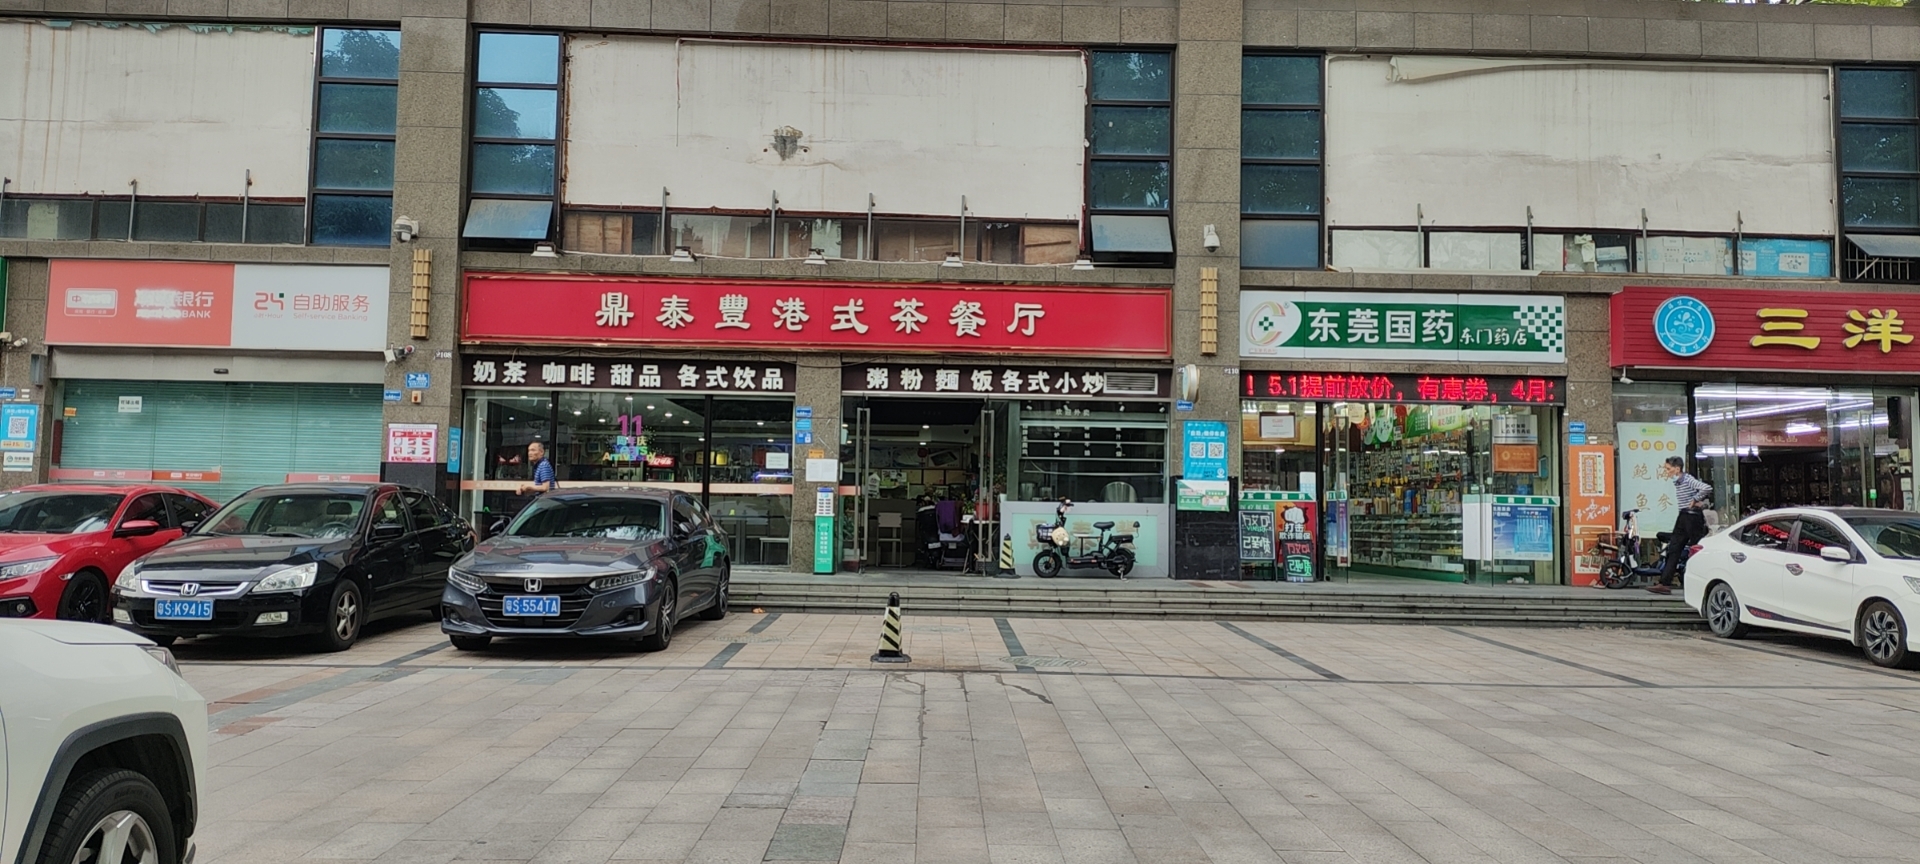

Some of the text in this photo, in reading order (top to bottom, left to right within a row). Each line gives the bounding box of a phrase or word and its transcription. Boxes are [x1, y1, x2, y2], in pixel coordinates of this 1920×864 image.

[254, 292, 285, 311] 24
[293, 293, 370, 313] 自助服务
[181, 310, 211, 319] BANK
[337, 313, 368, 321] Banking
[596, 292, 1046, 337] 鼎泰豐港式茶餐厅
[1308, 308, 1455, 344] 东莞国药
[1749, 308, 1915, 354] 三洋
[1459, 328, 1528, 346] 东门药店
[473, 360, 785, 390] 奶茶 咖啡 甜品 各式饮品
[617, 414, 642, 436] 11
[1631, 462, 1652, 512] 鲍鱼
[1284, 523, 1304, 533] 打击
